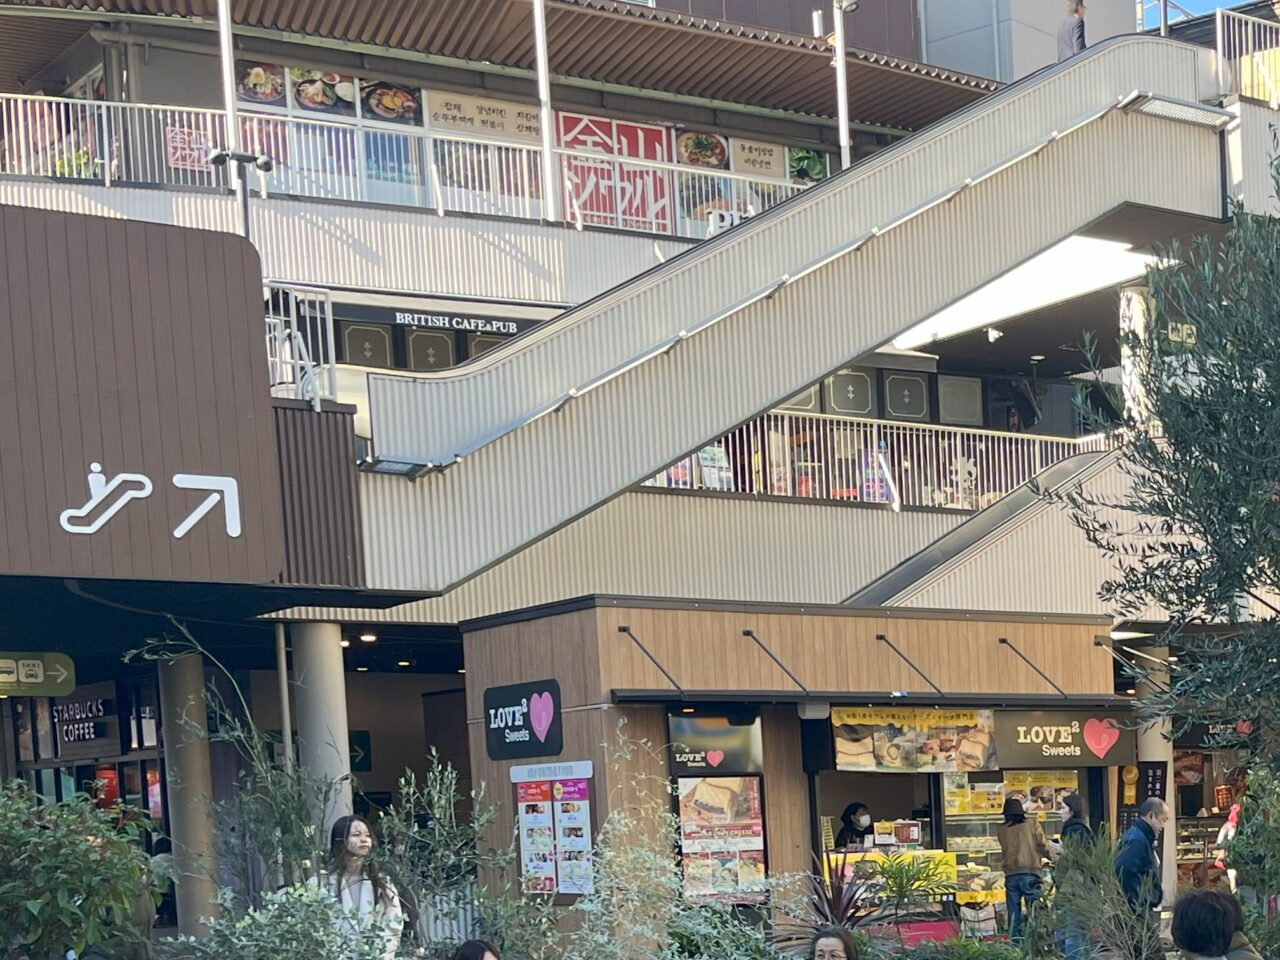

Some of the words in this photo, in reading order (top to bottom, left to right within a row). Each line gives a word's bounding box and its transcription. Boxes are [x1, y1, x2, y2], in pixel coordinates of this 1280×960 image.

[395, 312, 450, 328] BRITISH
[452, 317, 518, 333] CAFE&PUB
[53, 699, 104, 722] STARBUCKS
[63, 722, 96, 742] COFFEE
[504, 729, 530, 743] Sweets
[1042, 744, 1081, 756] Sweets
